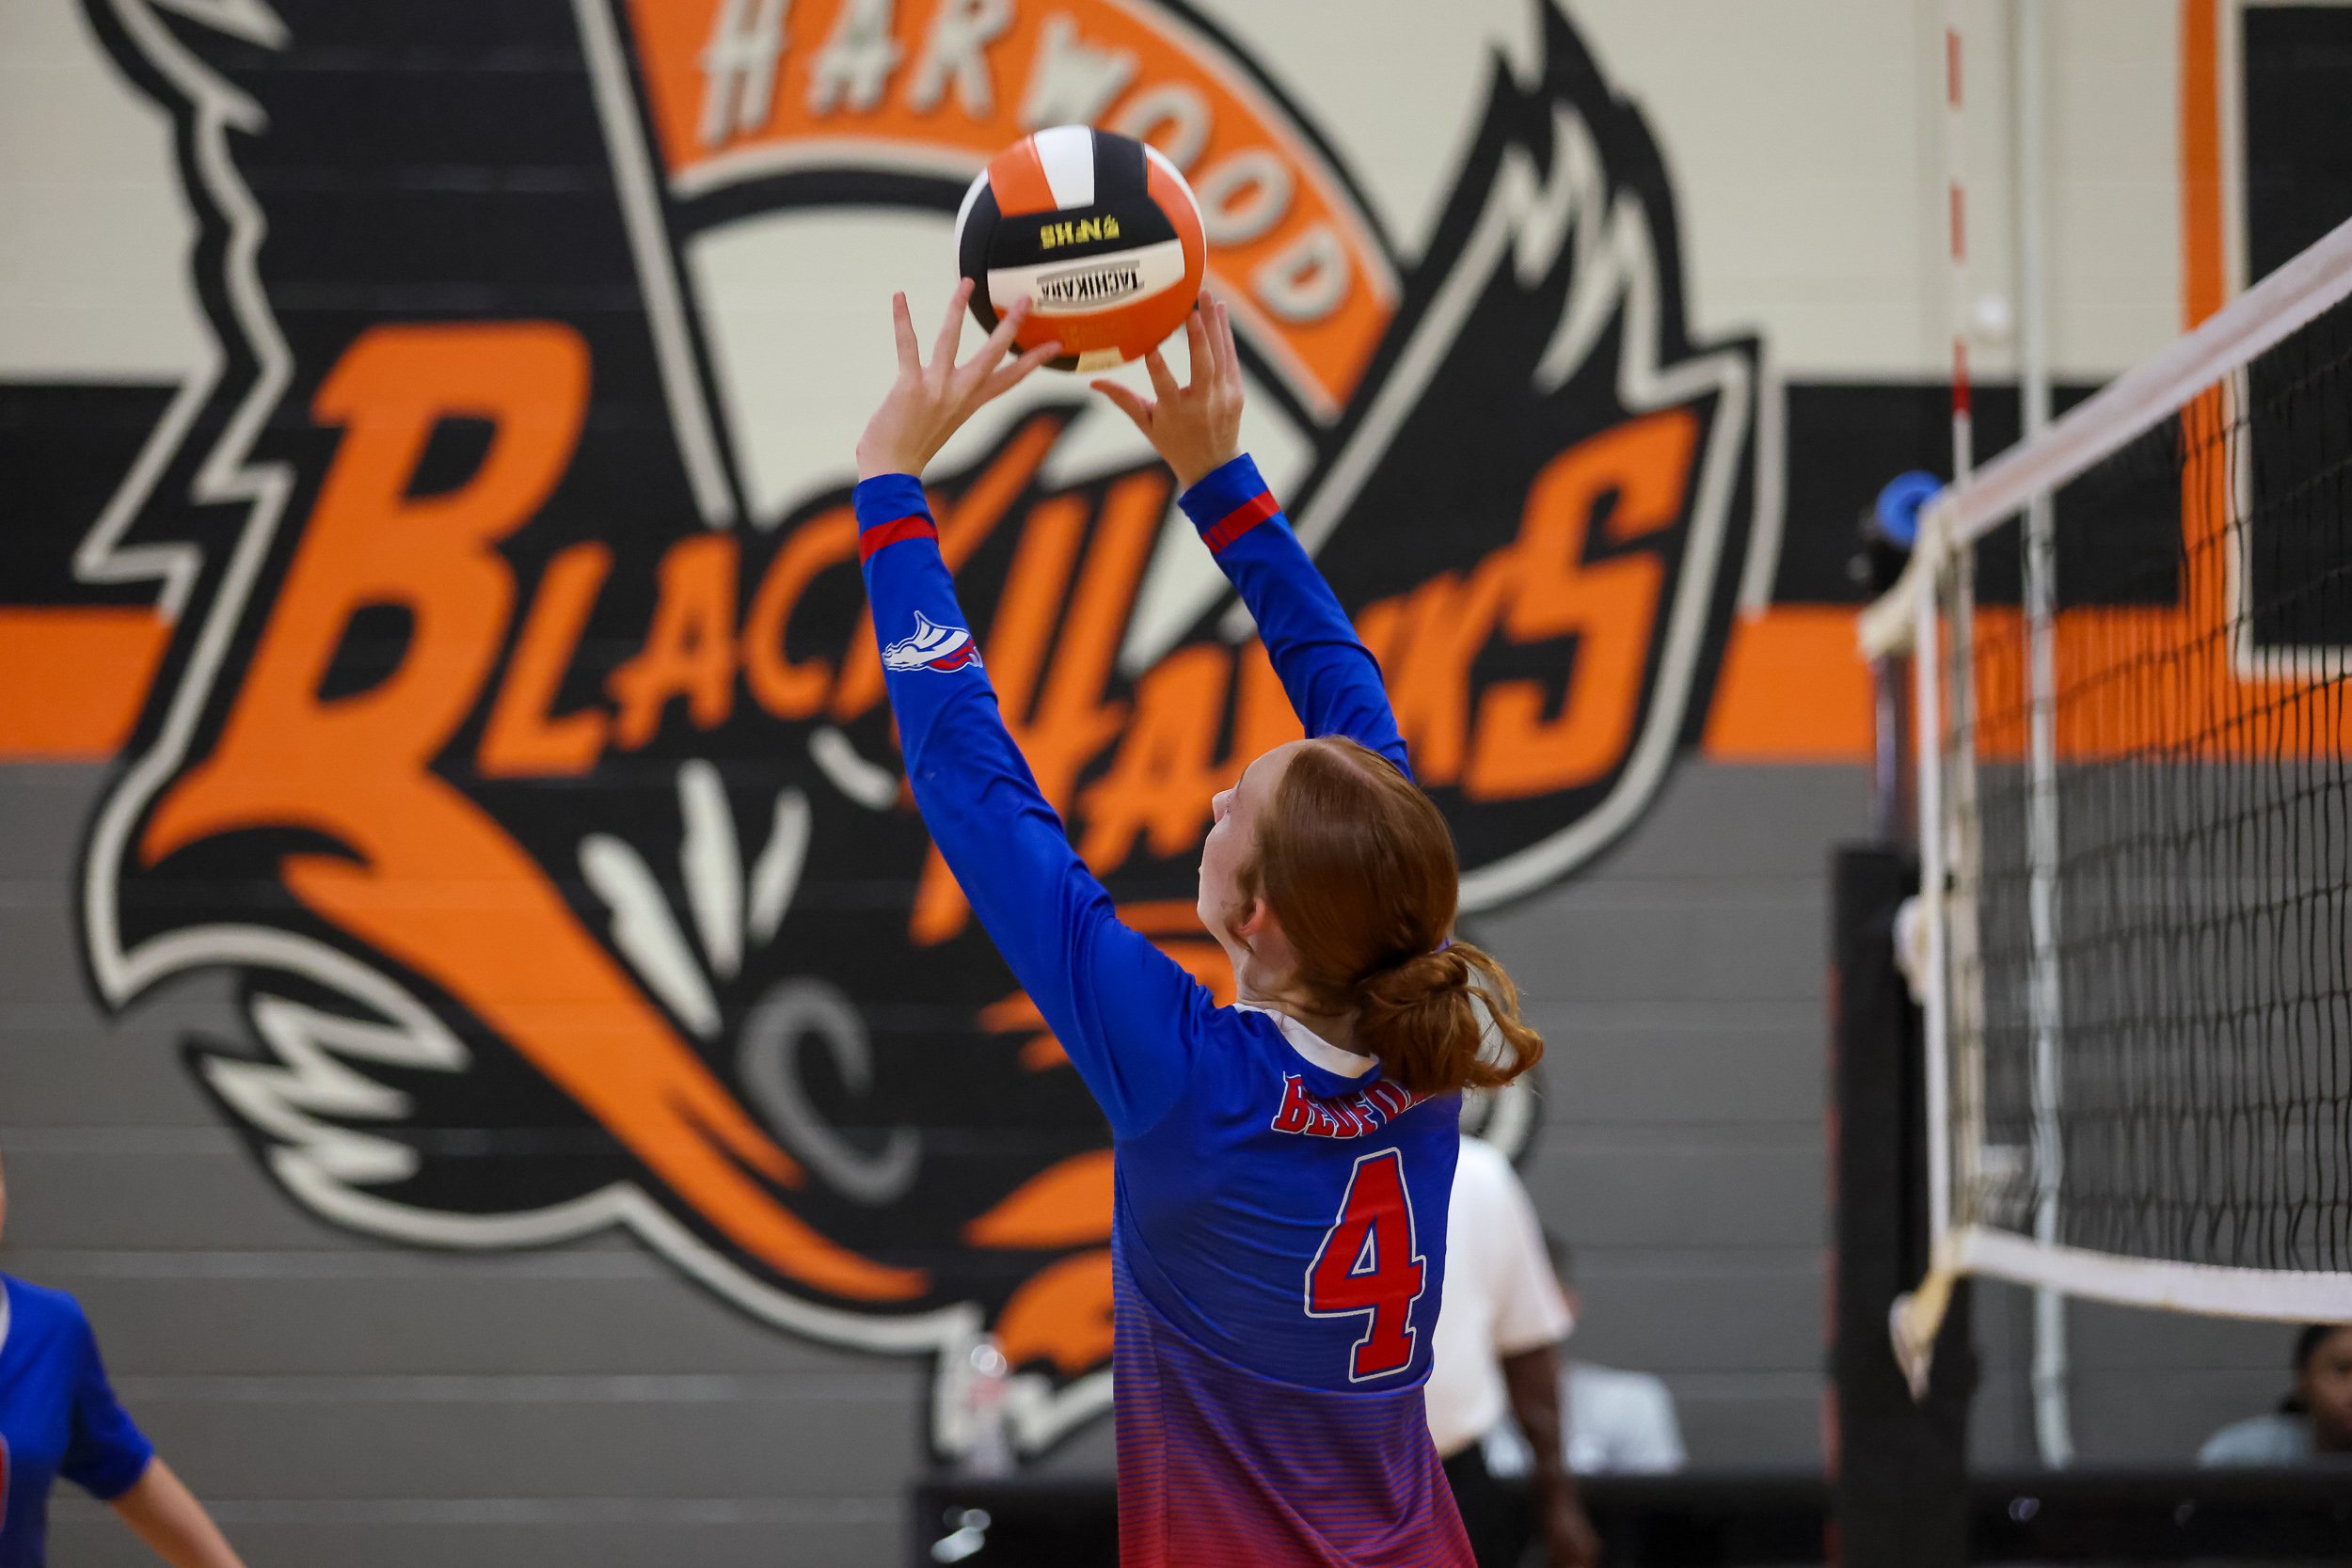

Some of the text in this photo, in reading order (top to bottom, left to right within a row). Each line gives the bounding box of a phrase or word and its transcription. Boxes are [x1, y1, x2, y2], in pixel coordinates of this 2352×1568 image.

[696, 0, 1352, 324] HARWOOD
[1040, 217, 1104, 250] NFHS
[1040, 268, 1139, 303] TACHIKARA
[1271, 1070, 1438, 1140] BEDFO
[1304, 1147, 1427, 1384] 4
